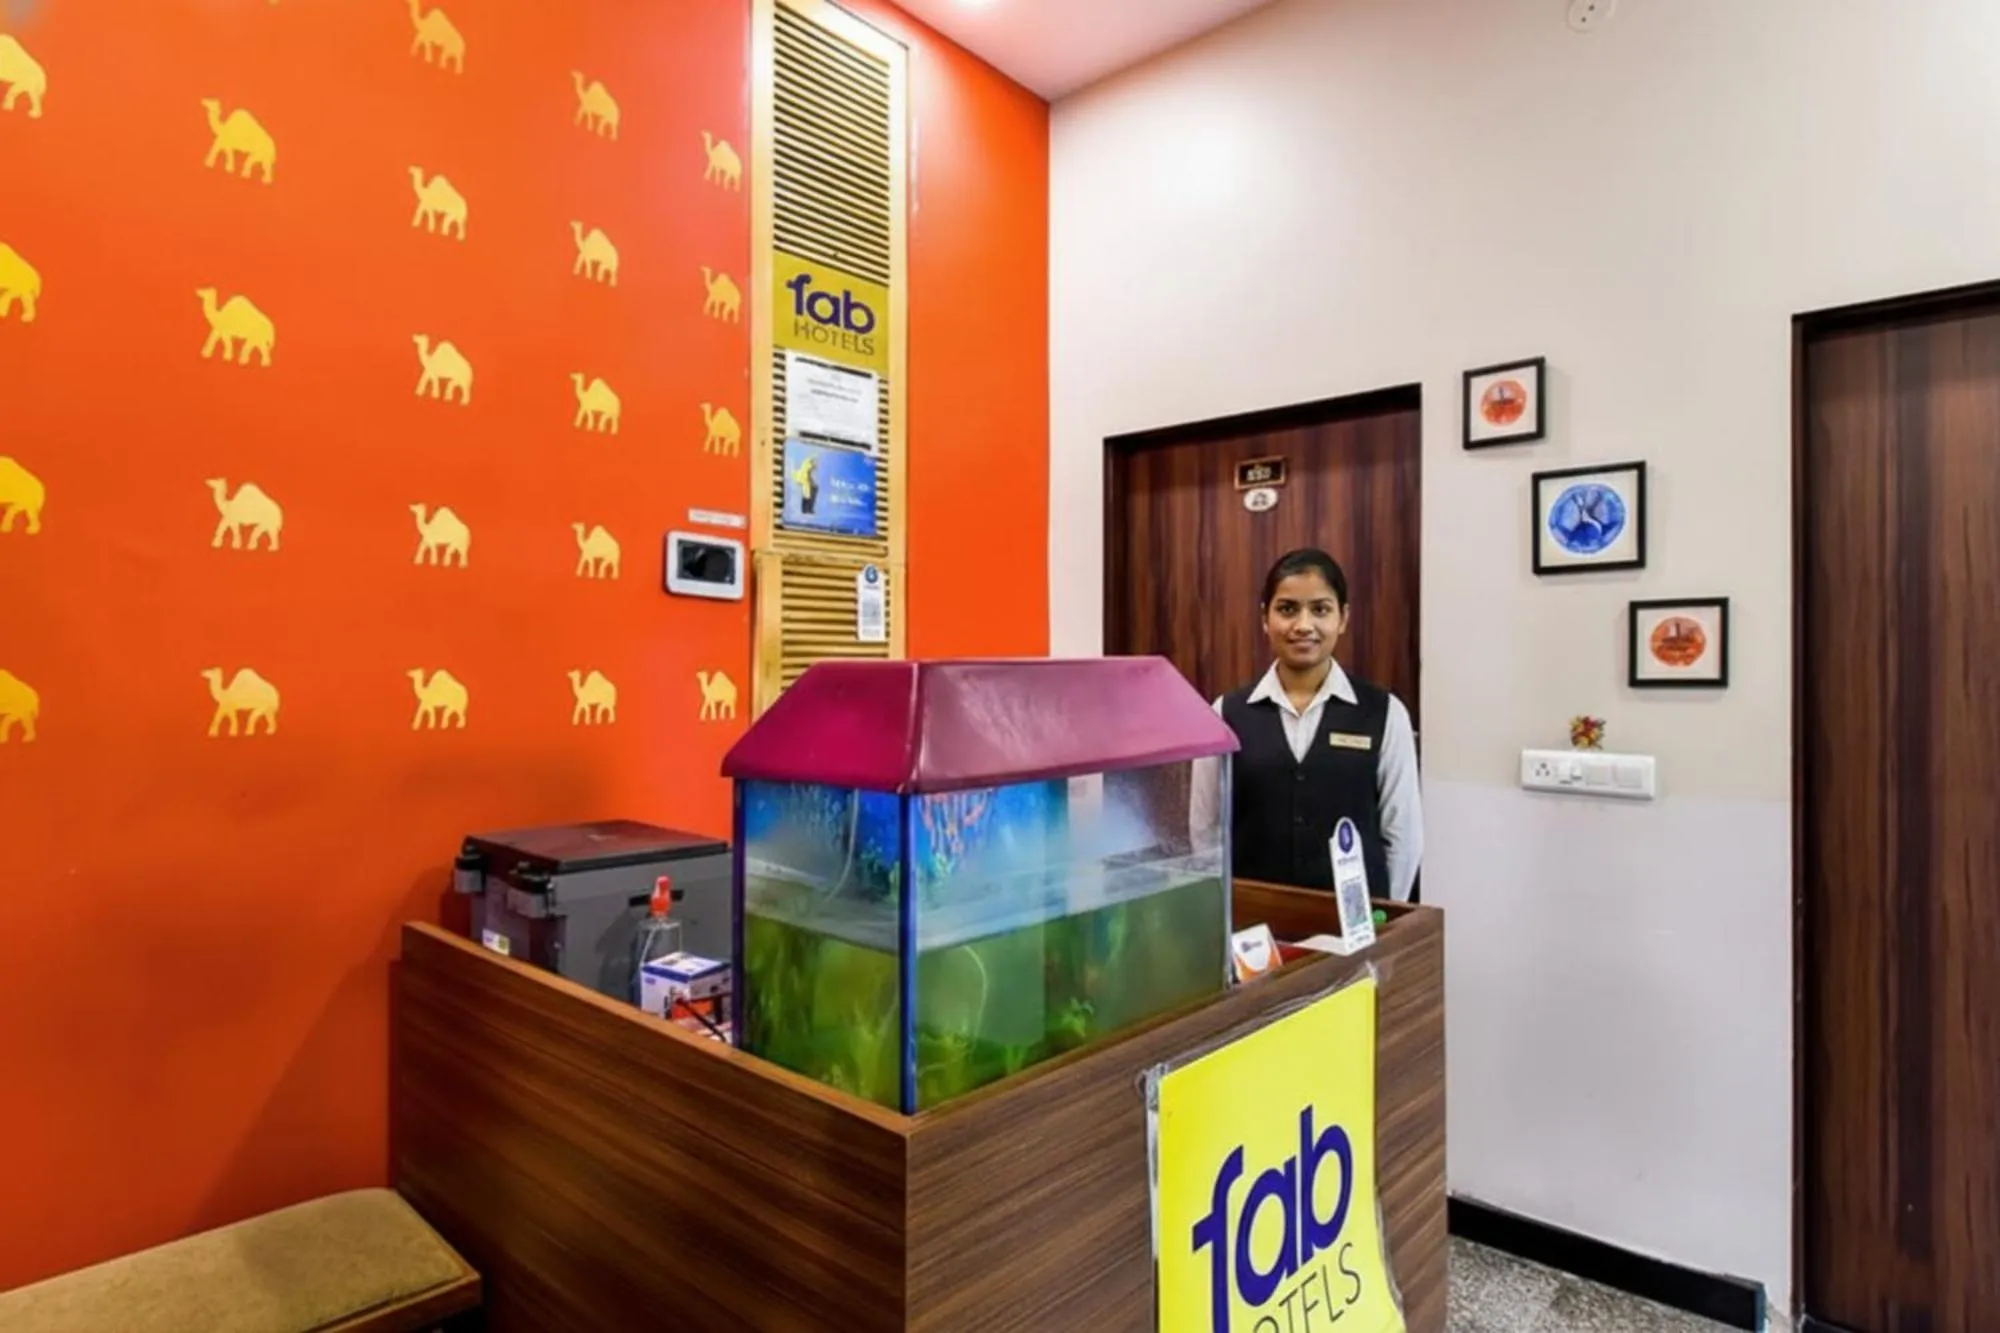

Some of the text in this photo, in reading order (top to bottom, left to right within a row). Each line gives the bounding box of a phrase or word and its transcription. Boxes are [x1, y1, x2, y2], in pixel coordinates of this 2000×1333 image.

[786, 273, 875, 334] fab
[794, 319, 874, 356] HOTELS
[1192, 1104, 1353, 1333] fab
